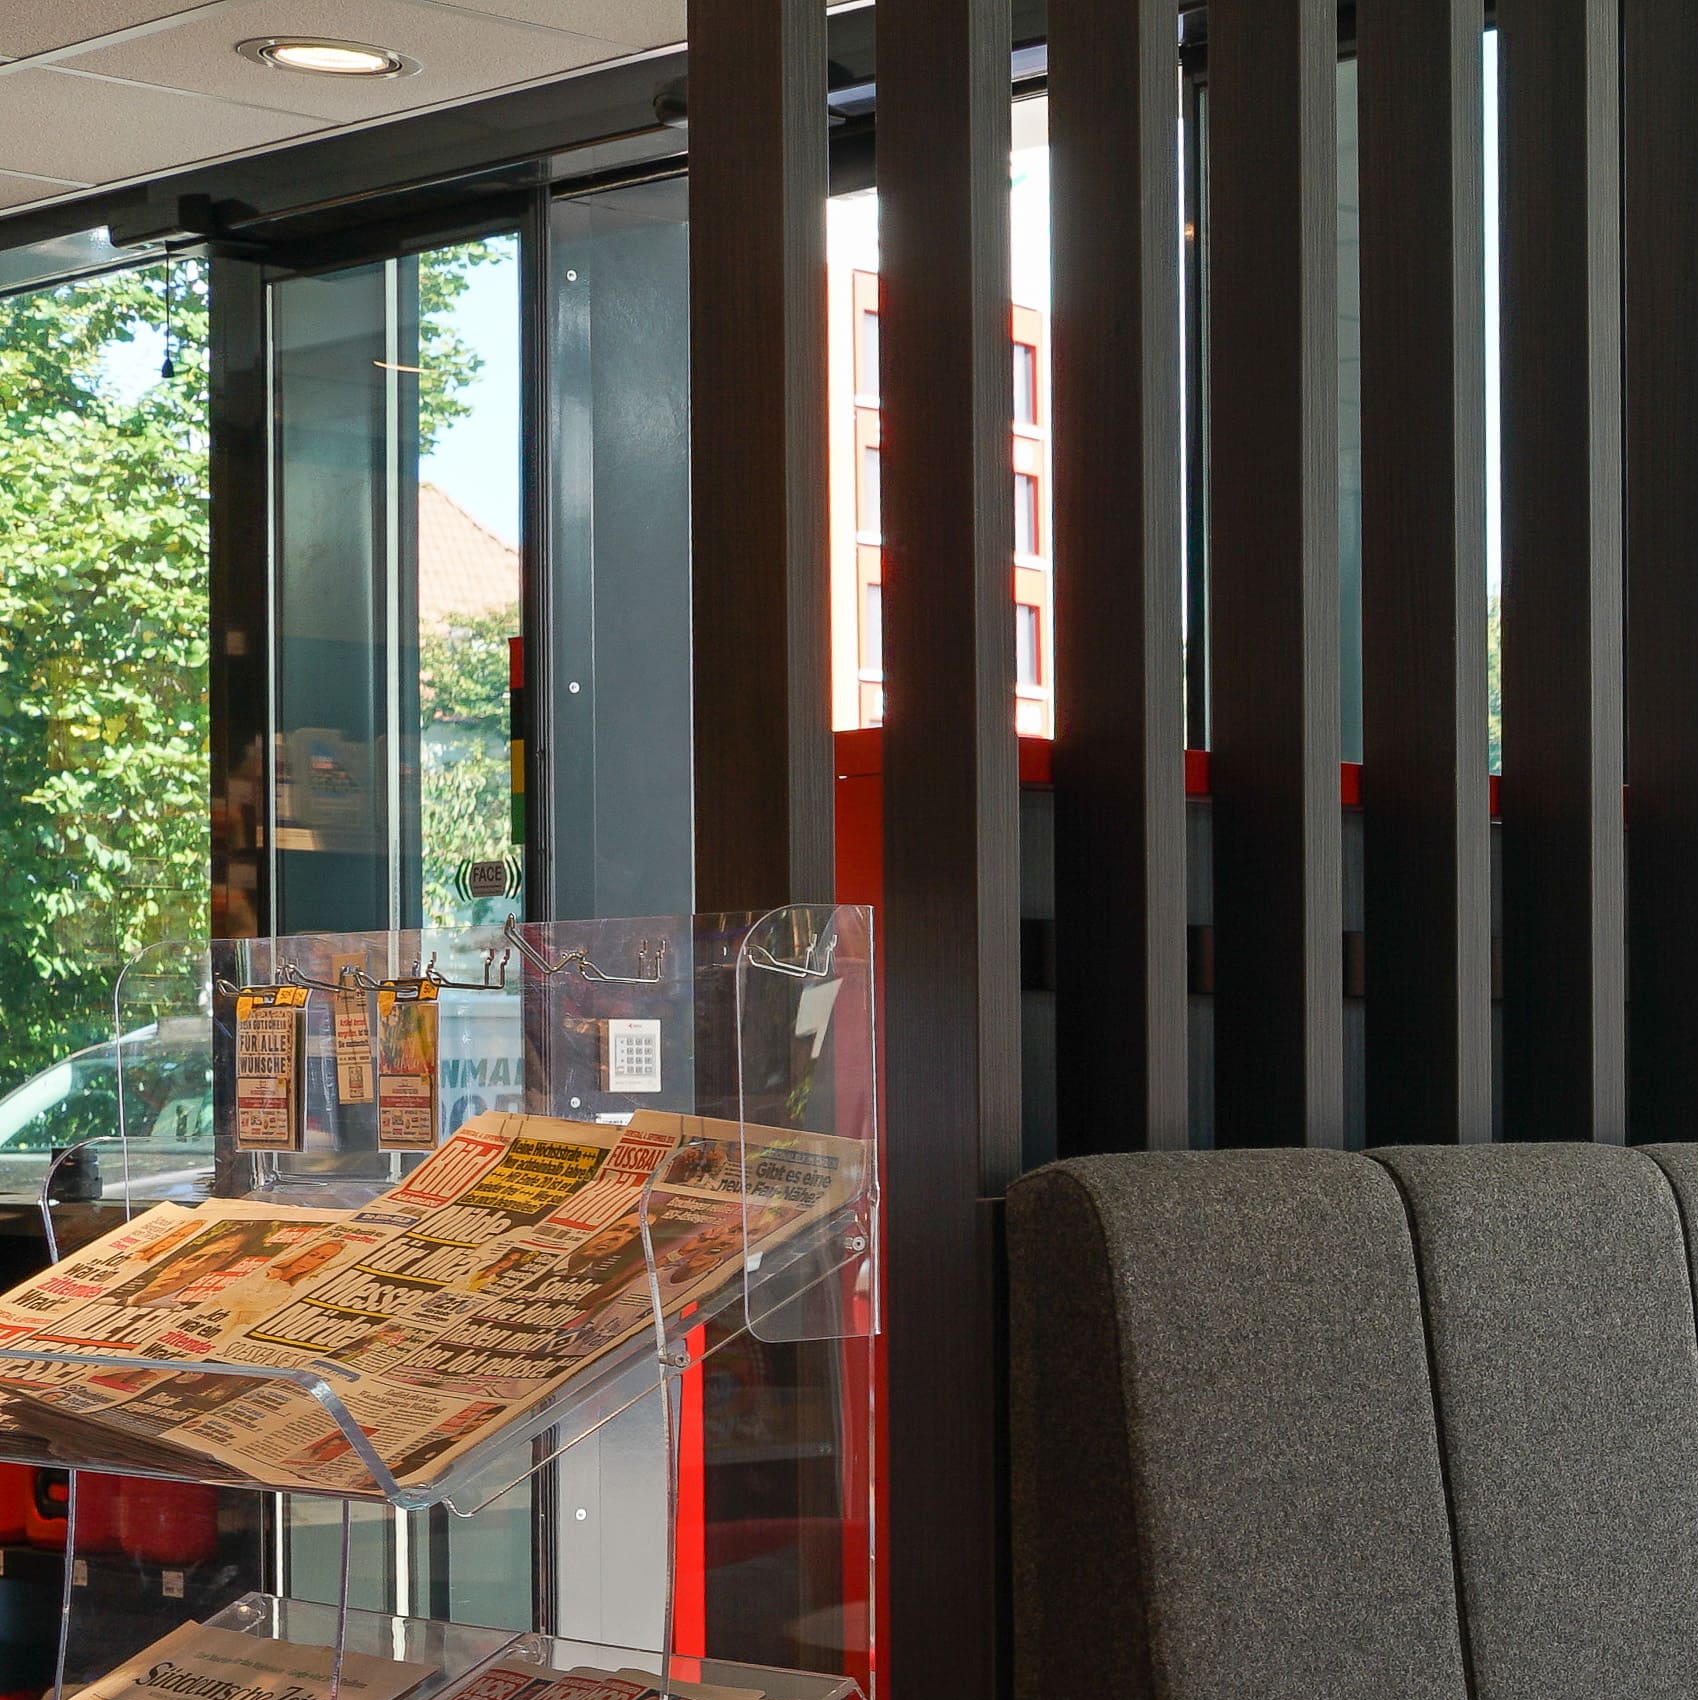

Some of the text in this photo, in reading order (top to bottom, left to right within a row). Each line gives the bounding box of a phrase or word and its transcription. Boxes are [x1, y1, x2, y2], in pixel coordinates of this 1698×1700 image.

[473, 865, 502, 883] FACE
[261, 1034, 286, 1052] ALLE
[240, 1056, 286, 1074] WÜNSCHE
[405, 1139, 503, 1198] Bild
[757, 1161, 832, 1189] Gibt es eine
[411, 1205, 514, 1244] Milde
[359, 1237, 432, 1273] für
[63, 1262, 120, 1282] war ein
[35, 1276, 110, 1299] zitterndes
[480, 1299, 525, 1320] wie
[513, 1302, 587, 1329] Holtby
[157, 1330, 217, 1354] zitterndes
[444, 1317, 516, 1347] haben
[500, 1328, 558, 1351] mich
[402, 1343, 455, 1370] den
[439, 1347, 489, 1376] Job
